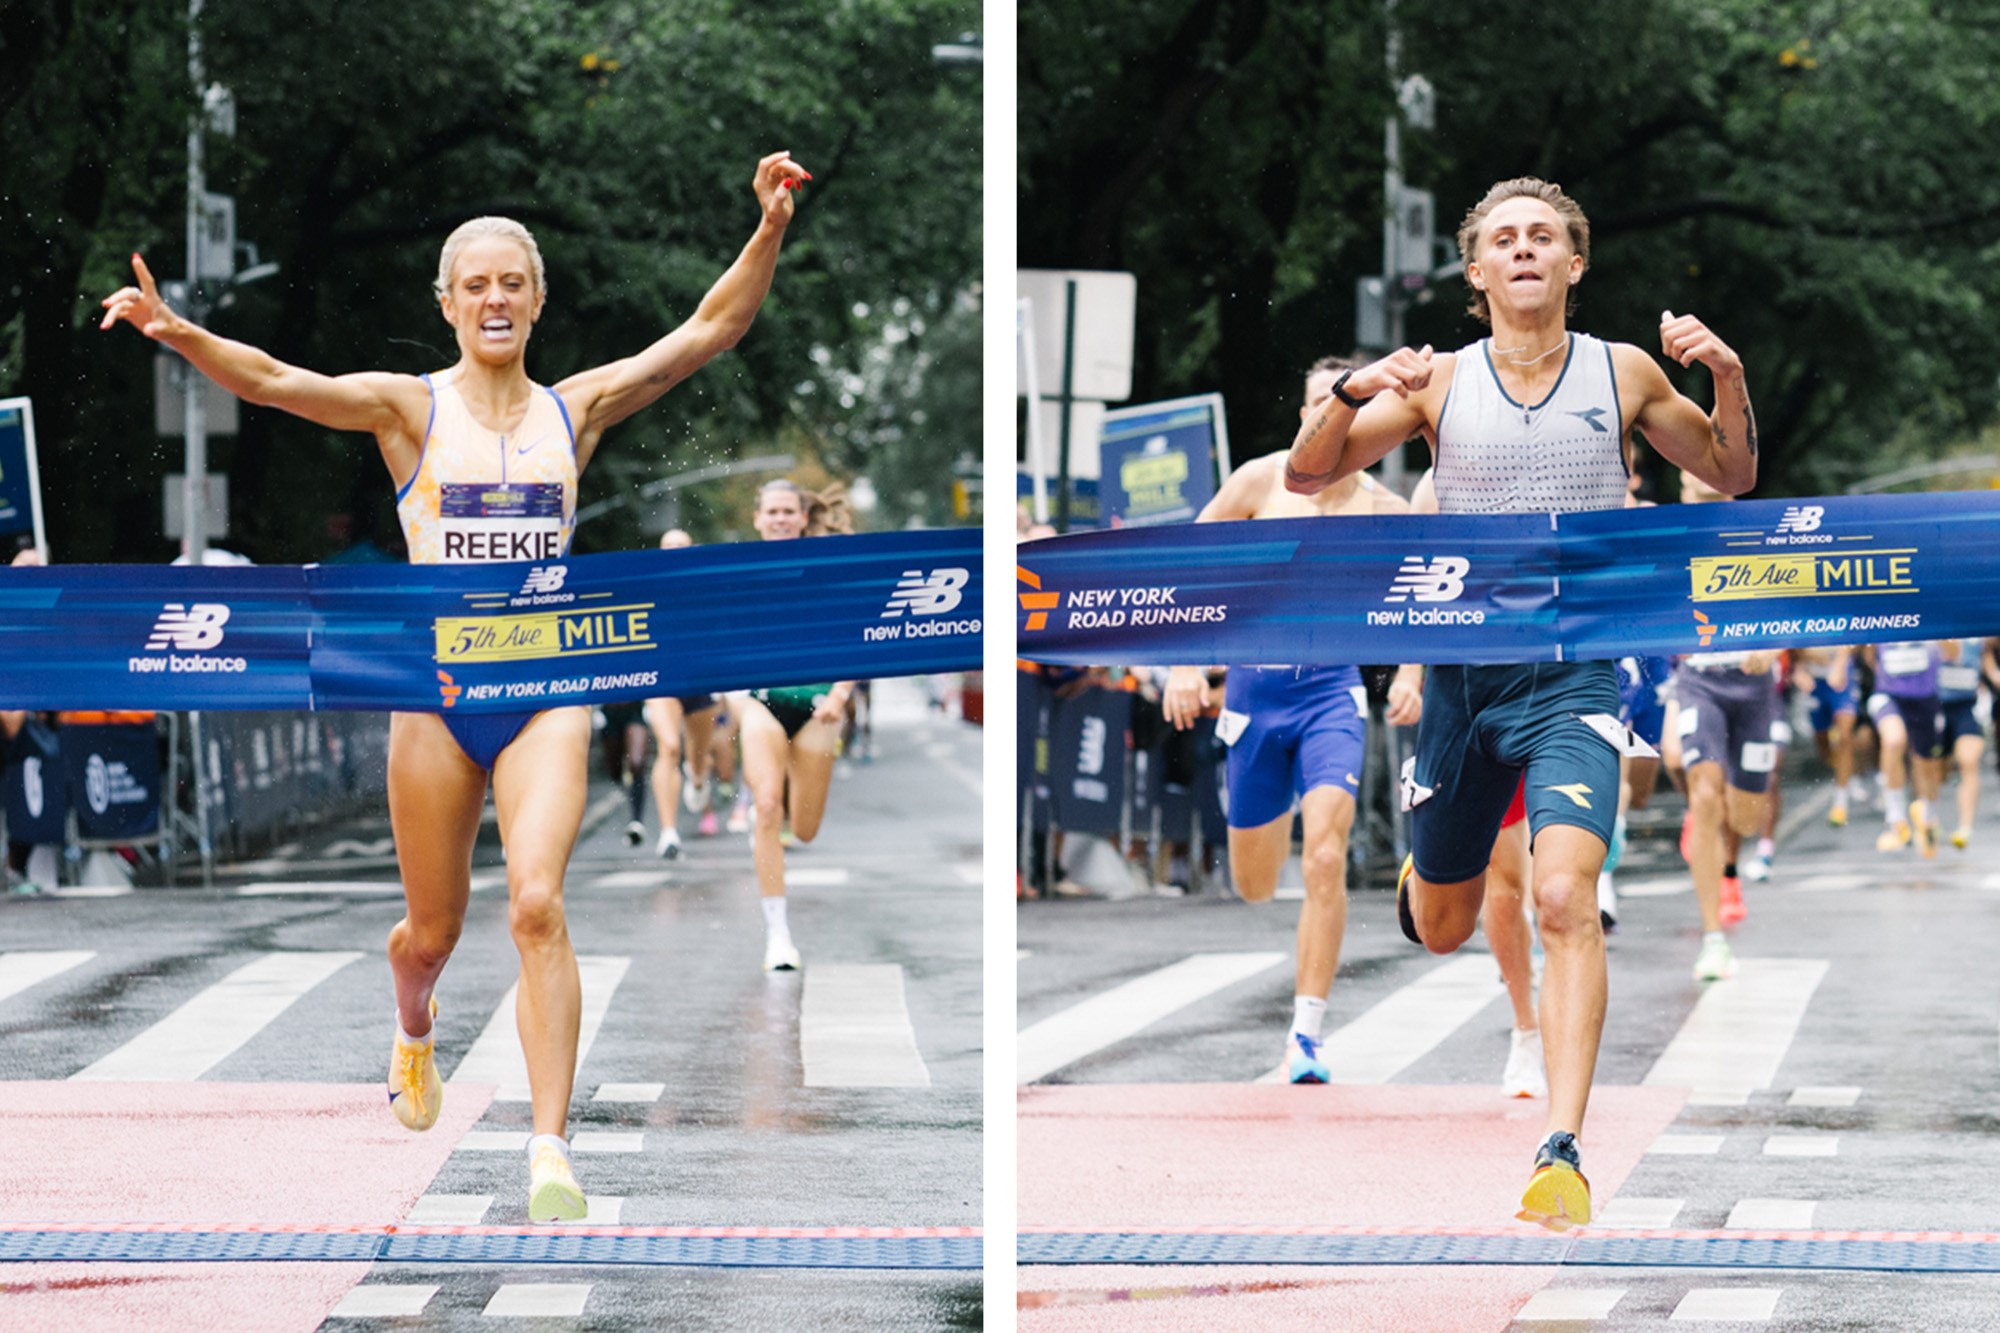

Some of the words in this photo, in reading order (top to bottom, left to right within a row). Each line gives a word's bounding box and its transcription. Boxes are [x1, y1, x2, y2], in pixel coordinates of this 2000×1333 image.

[1775, 505, 1825, 534] NB
[445, 531, 559, 560] REEKIE
[1765, 536, 1788, 546] new
[1789, 533, 1834, 545] balance
[520, 565, 567, 594] NB
[1383, 556, 1470, 602] NB
[1704, 564, 1752, 594] 5th
[1823, 557, 1912, 588] MILE
[510, 596, 532, 607] new
[533, 593, 575, 605] balance
[880, 567, 970, 618] NB
[1067, 589, 1117, 608] NEW
[1120, 586, 1177, 606] YORK
[145, 603, 230, 650] NB
[864, 625, 901, 642] new
[905, 619, 982, 638] balance
[1068, 610, 1126, 629] ROAD
[1130, 605, 1227, 626] RUNNERS
[1367, 611, 1405, 625] new
[1408, 607, 1485, 625] balance
[1723, 622, 1759, 638] NEW
[1760, 619, 1802, 636] YORK
[1805, 616, 1847, 633] ROAD
[1849, 613, 1921, 631] RUNNERS
[450, 626, 495, 655] 5th
[565, 612, 650, 647] MILE
[129, 657, 167, 672] new
[170, 654, 247, 672] balance
[466, 684, 505, 700] NEW
[506, 681, 547, 697] YORK
[549, 677, 590, 694] ROAD
[591, 671, 658, 691] RUNNERS
